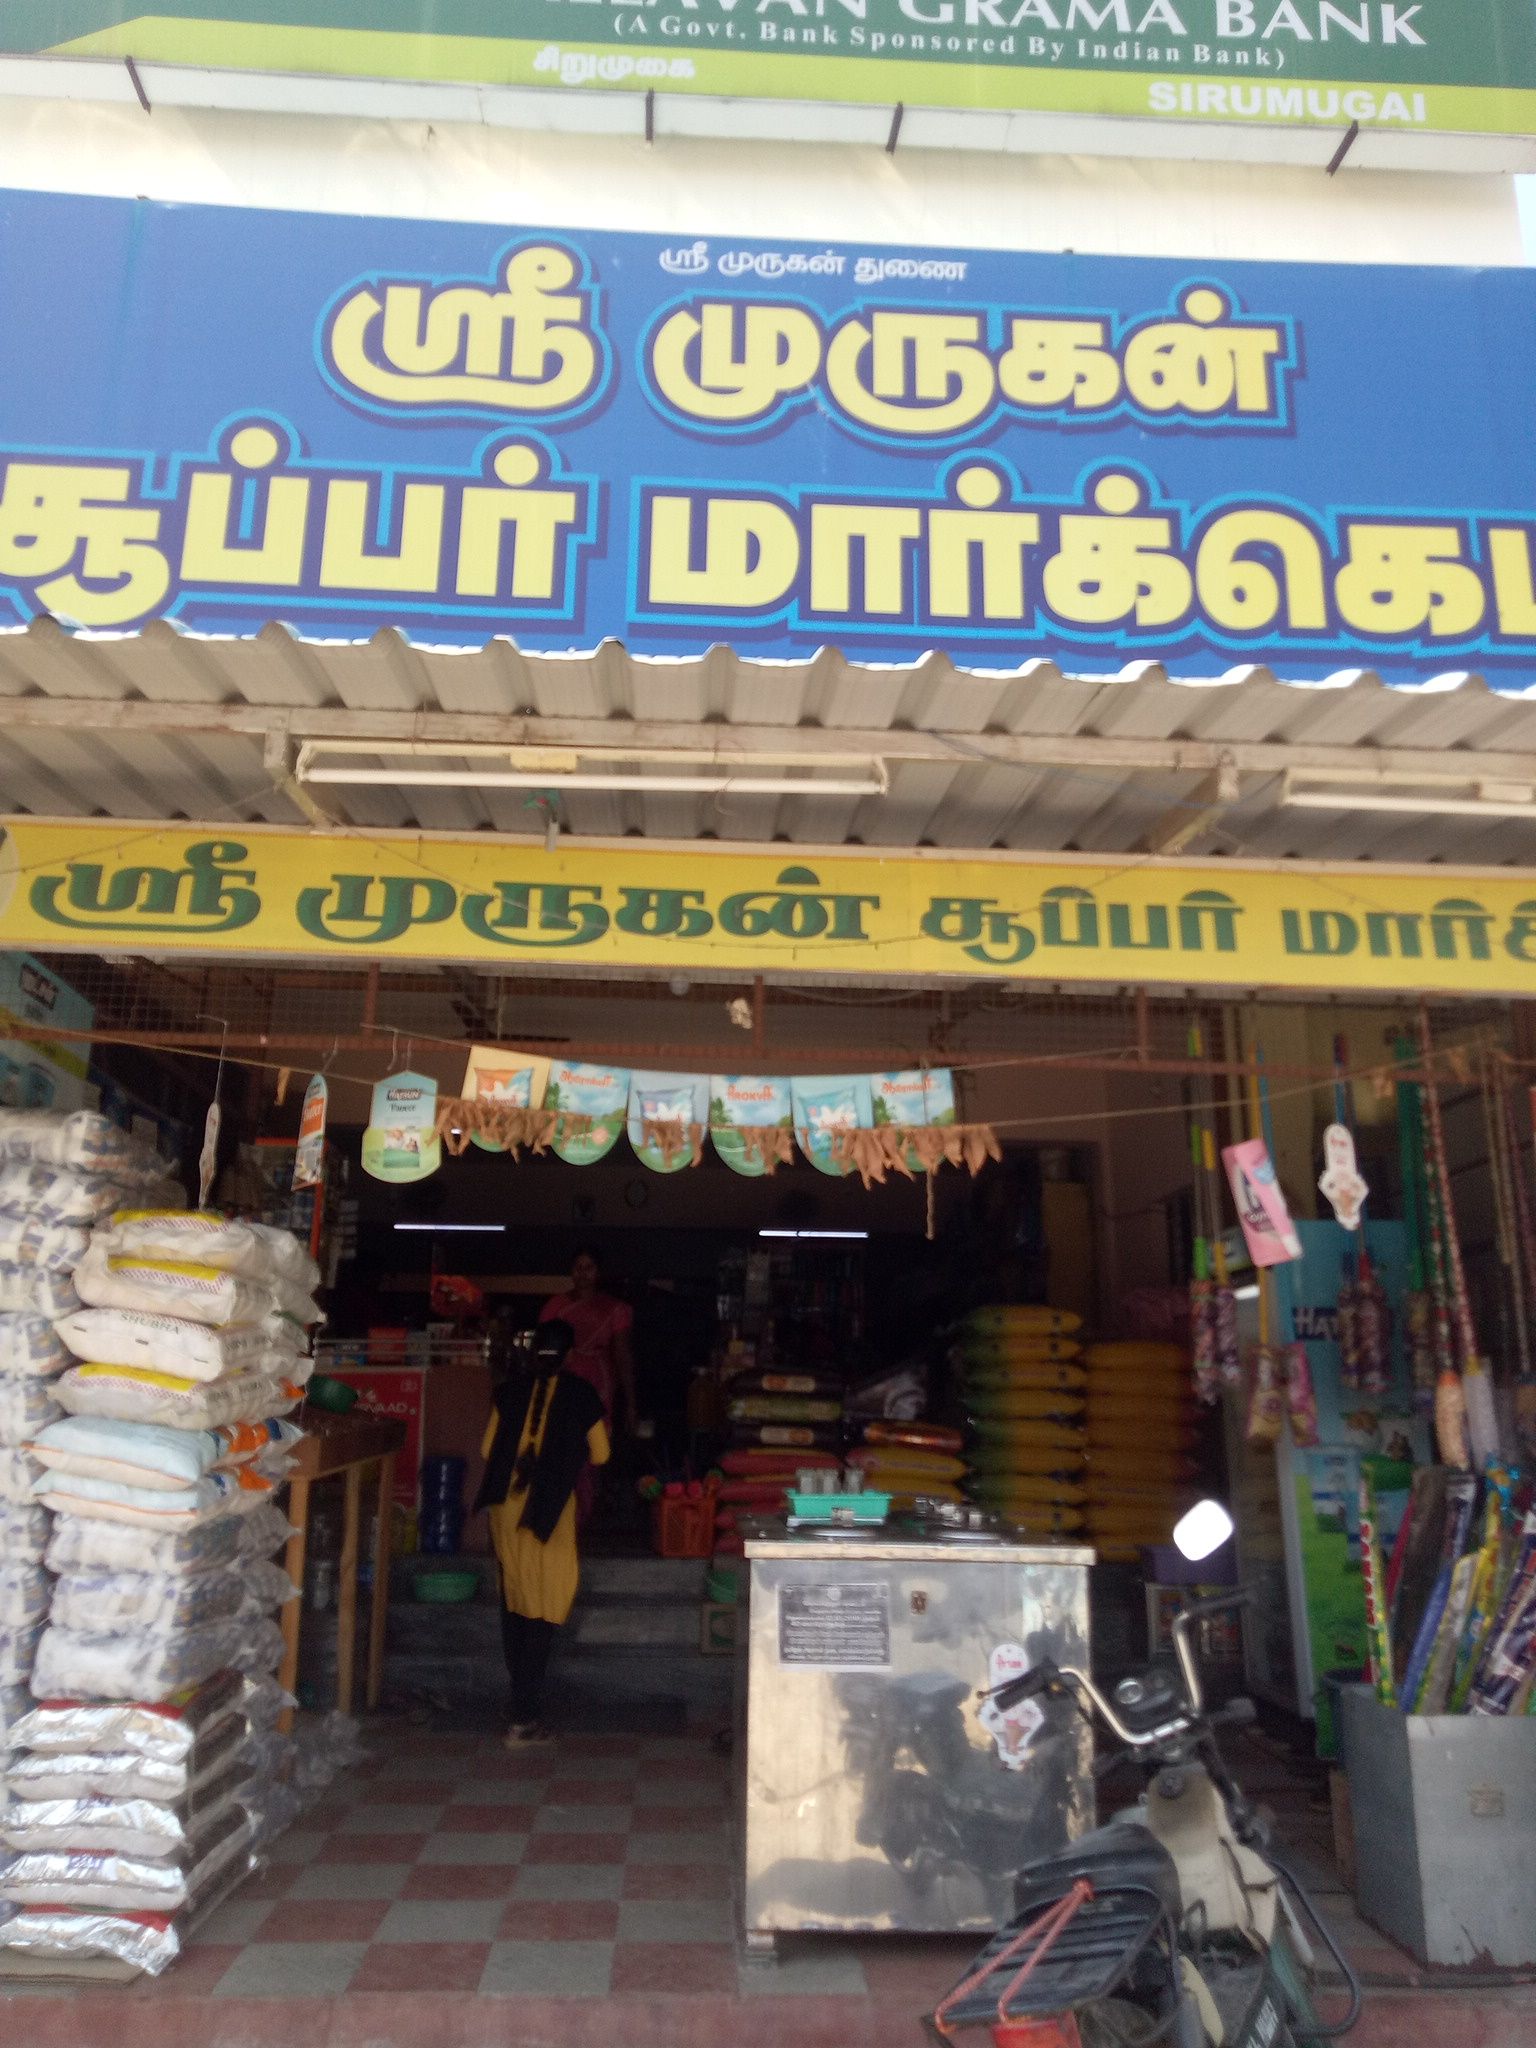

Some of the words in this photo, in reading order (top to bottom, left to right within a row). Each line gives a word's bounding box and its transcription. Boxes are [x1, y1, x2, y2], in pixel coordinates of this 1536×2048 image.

[613, 13, 648, 36] (A
[660, 15, 747, 40] Govt.
[759, 20, 839, 45] Bank
[850, 26, 1015, 55] Sponsored
[1028, 35, 1065, 62] By
[1078, 38, 1180, 62] Indian
[1193, 43, 1286, 71] Bank)
[1216, 0, 1427, 46] BANK
[532, 44, 697, 85] சிறுமுகை
[1148, 80, 1427, 122] SIRUMUGAI
[717, 249, 847, 280] முருகன்
[853, 255, 968, 286] துணை
[330, 246, 597, 410] ஸ்ரீ
[652, 289, 1280, 434] முருகன்
[0, 426, 578, 627] சூப்பர்
[29, 840, 261, 933] ஸ்ரீ
[295, 865, 881, 947] முருகன்
[919, 885, 1243, 965] சூப்பர்
